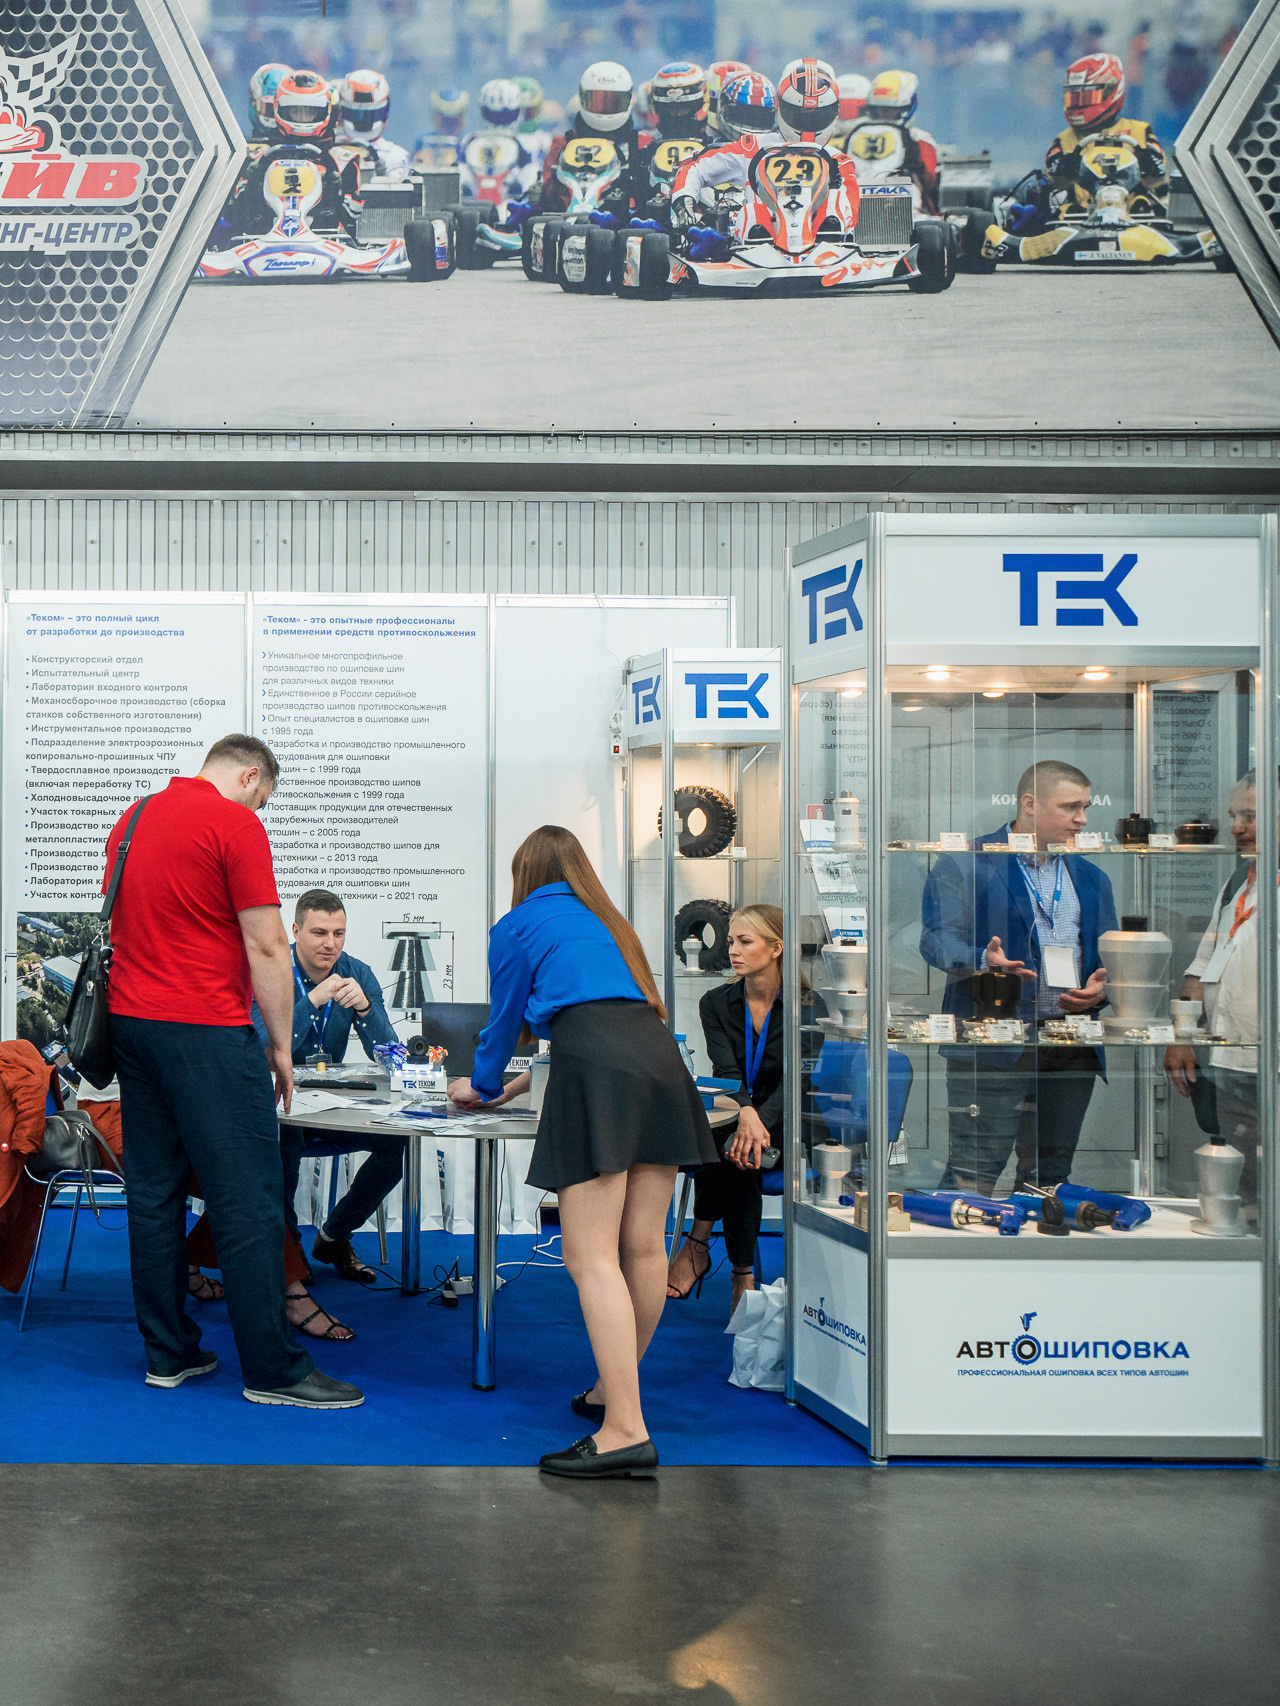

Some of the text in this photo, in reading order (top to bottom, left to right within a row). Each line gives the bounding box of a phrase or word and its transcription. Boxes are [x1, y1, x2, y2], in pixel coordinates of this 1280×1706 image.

[773, 159, 815, 183] 23
[862, 186, 911, 196] ITAKA
[95, 614, 132, 622] полный
[376, 616, 454, 626] профессионалы
[40, 628, 184, 638] разработки производства
[272, 629, 332, 637] применении
[335, 630, 374, 638] средств
[32, 669, 139, 679] Испытательный центр
[32, 683, 94, 693] Лаборатория
[144, 685, 187, 693] контроля
[32, 697, 226, 707] Механосборочное производство (сборка
[134, 711, 201, 721] изготовления)
[32, 725, 191, 735] Инструментальное производство
[32, 738, 203, 749] Подразделение электроэрозионных
[267, 739, 465, 750] Разработка производство промышленного
[26, 752, 176, 762] копировально-прошивных ЧПУ
[31, 766, 180, 778] Твердосплавное производство
[319, 765, 339, 773] 1999
[26, 780, 150, 790] (включая переработку ТС)
[328, 780, 390, 788] производство
[31, 793, 131, 804] Холодновысадочное
[267, 802, 317, 813] Поставщик
[320, 805, 366, 814] продукции
[71, 810, 116, 818] токарных
[270, 816, 398, 826] зарубежных производителей
[31, 821, 98, 832] Производство
[318, 828, 338, 836] 2005
[341, 830, 360, 838] года
[329, 843, 391, 851] производство
[31, 848, 98, 861] Производство
[31, 863, 98, 873] Производство
[273, 865, 465, 877] азработка производство промышленного
[30, 877, 93, 887] Лаборатория
[395, 892, 414, 900] 2021
[402, 913, 411, 923] 15
[443, 978, 452, 990] 23
[802, 1304, 867, 1347] АВТОШИПОВКА
[956, 1334, 1191, 1366] АВТОШИПОВКА
[957, 1369, 1047, 1377] ПРОФЕССИОНАЛЬНАЯ
